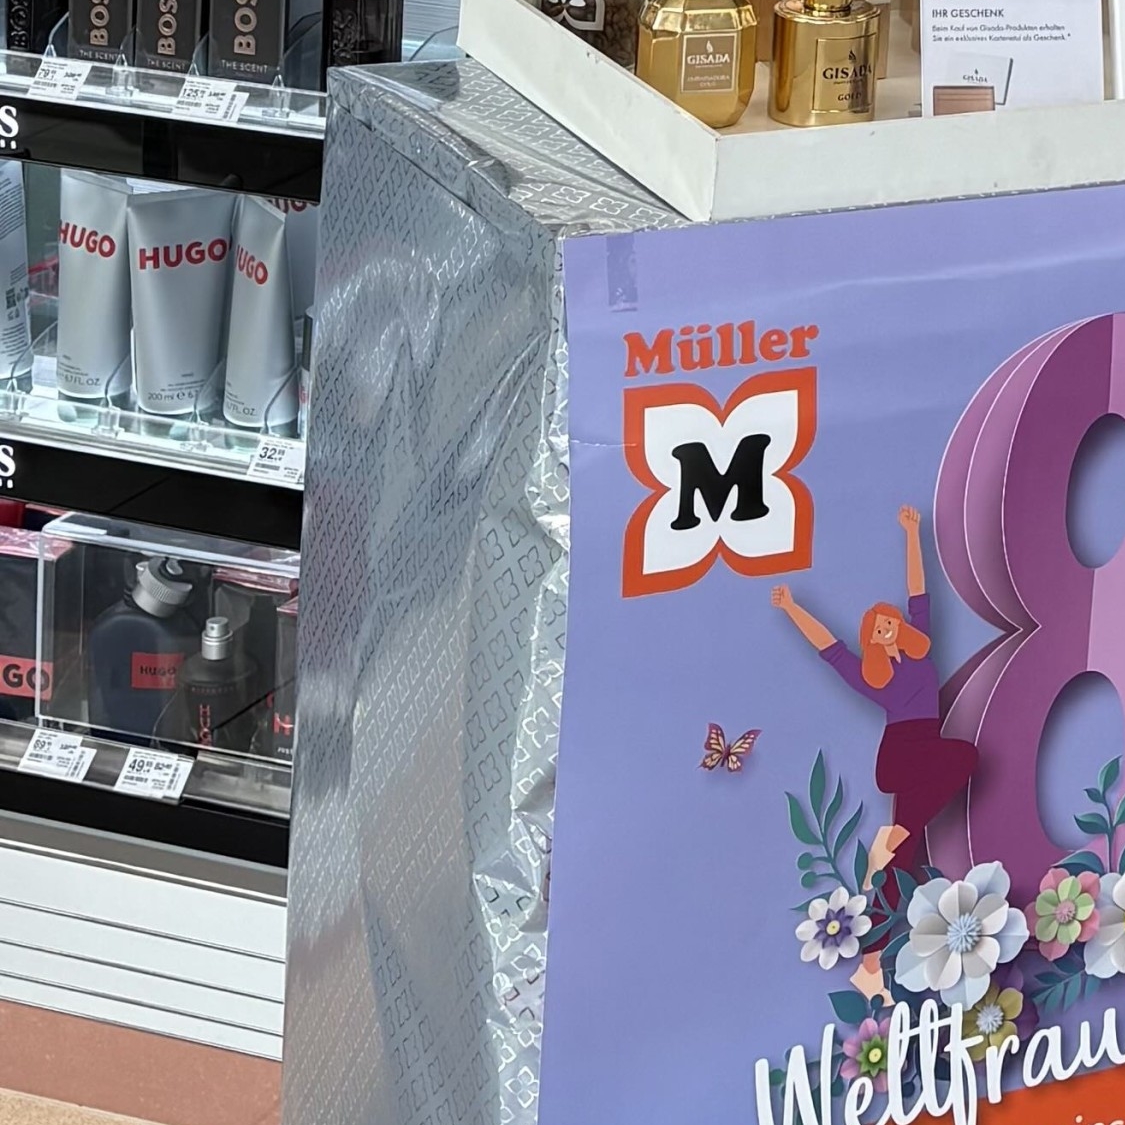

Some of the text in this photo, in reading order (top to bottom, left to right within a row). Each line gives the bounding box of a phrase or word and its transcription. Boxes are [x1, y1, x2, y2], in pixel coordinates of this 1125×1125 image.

[932, 8, 1004, 18] IHR GESCHENK
[1039, 23, 1065, 31] erhalten
[221, 59, 268, 74] THE SCENT
[686, 53, 731, 65] GISADA
[822, 64, 873, 81] GISADA
[58, 220, 116, 259] HUGO
[138, 237, 228, 270] HUGO
[623, 319, 820, 377] Müller
[670, 433, 772, 531] M
